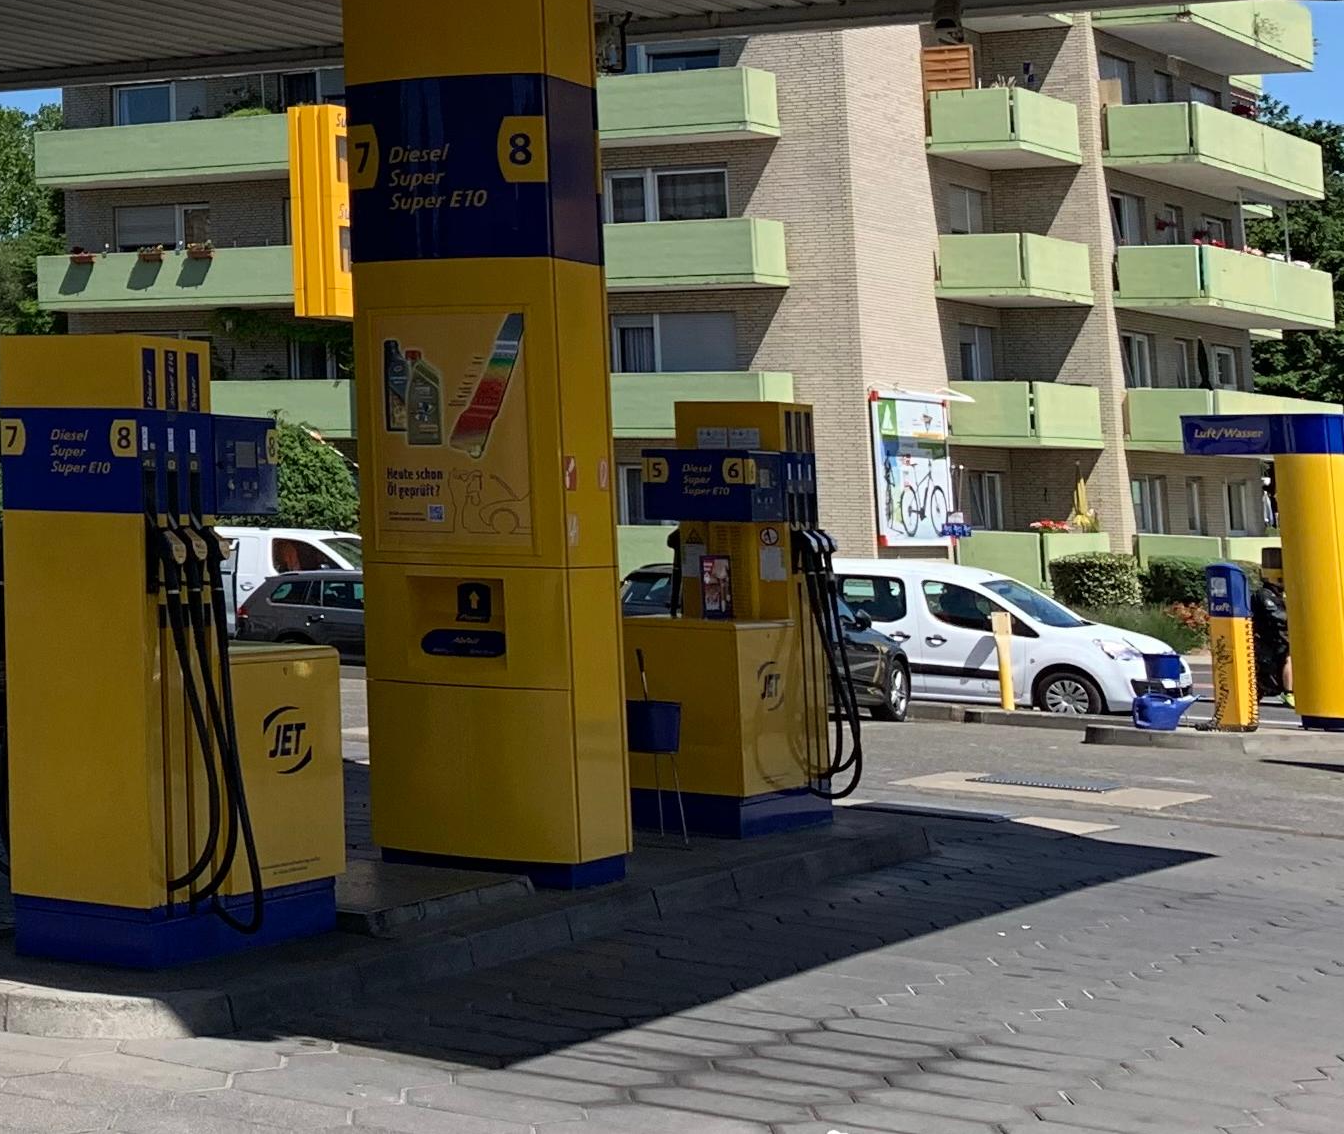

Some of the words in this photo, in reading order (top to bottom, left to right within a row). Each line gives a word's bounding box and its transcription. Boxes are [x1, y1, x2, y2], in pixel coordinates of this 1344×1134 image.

[389, 143, 450, 164] Diesel
[509, 133, 532, 165] 8
[355, 142, 370, 174] 7
[389, 169, 446, 191] Super
[389, 192, 446, 215] Super
[450, 189, 488, 207] E10
[6, 426, 17, 447] 7
[50, 428, 89, 442] Diesel
[117, 427, 131, 448] 8
[1194, 427, 1263, 440] Luft/Wasser
[50, 444, 86, 460] Super
[50, 461, 86, 476] Super
[88, 461, 111, 474] E10
[387, 467, 413, 479] Heute
[416, 467, 443, 479] schon
[652, 463, 662, 478] 5
[682, 464, 712, 473] Diesel
[728, 463, 739, 478] 6
[683, 475, 710, 486] Super
[387, 481, 397, 496] Öl
[682, 486, 711, 497] Super
[712, 487, 730, 496] E10
[1211, 602, 1229, 612] Luft
[269, 722, 306, 758] JET
